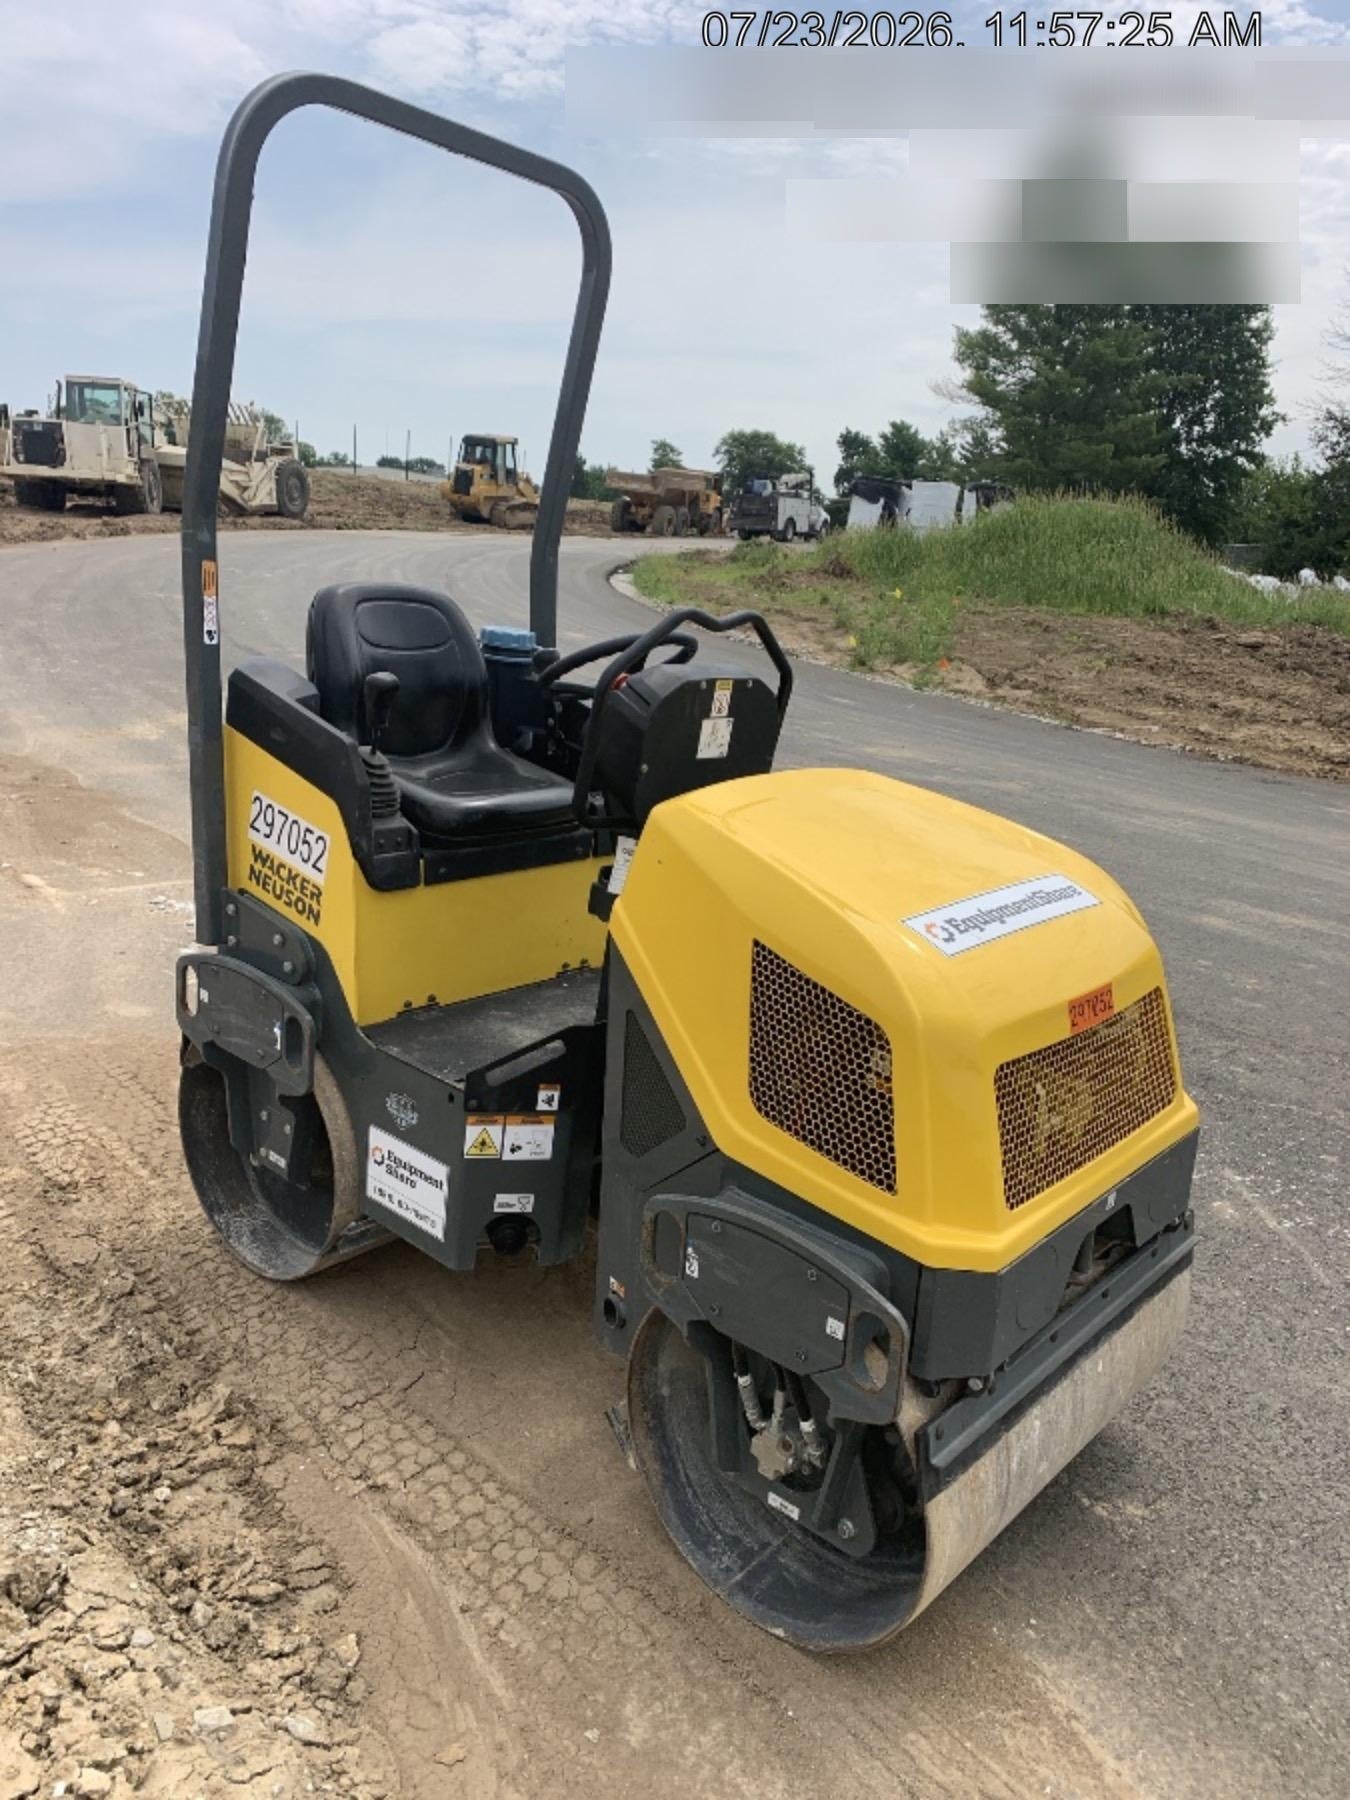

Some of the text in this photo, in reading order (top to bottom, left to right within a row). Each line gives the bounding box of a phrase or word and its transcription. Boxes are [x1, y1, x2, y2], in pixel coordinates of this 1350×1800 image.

[249, 794, 327, 874] 297052
[249, 863, 321, 926] NEUSON
[251, 843, 323, 907] WACKER
[384, 1163, 417, 1189] Share
[386, 1149, 445, 1191] Equipment
